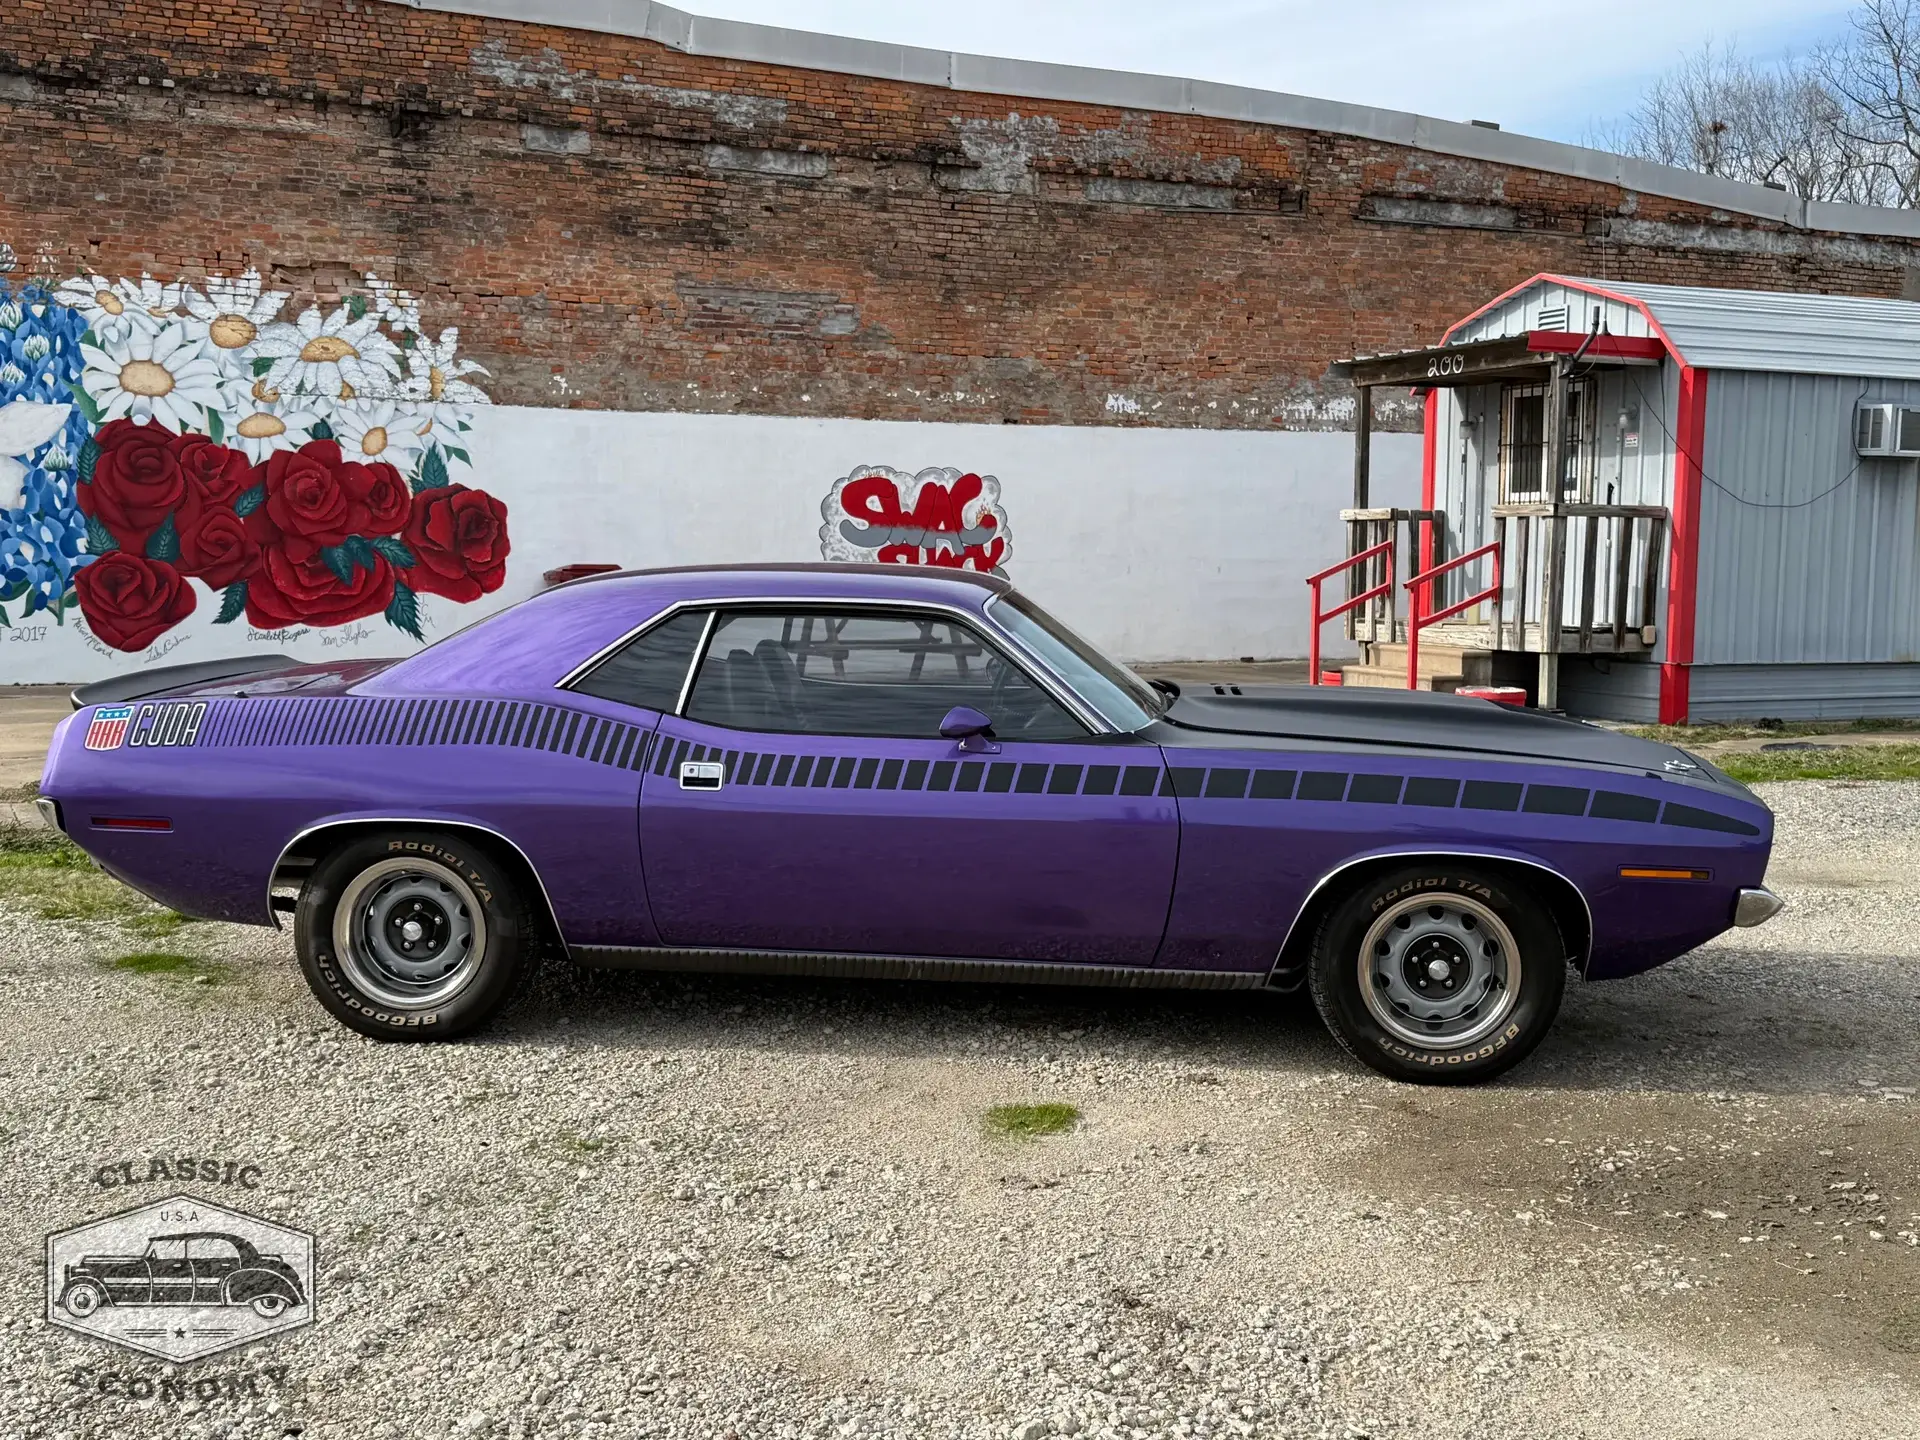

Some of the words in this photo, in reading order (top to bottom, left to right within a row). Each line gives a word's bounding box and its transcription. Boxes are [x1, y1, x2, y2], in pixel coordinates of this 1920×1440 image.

[1427, 354, 1465, 378] 200
[10, 626, 47, 642] 2017
[128, 701, 208, 748] CUDA
[388, 840, 465, 868] Radial
[469, 869, 493, 903] T/A
[1371, 876, 1448, 912] Radial
[1457, 879, 1492, 900] T/A
[317, 954, 438, 1026] BFGoodrich
[1379, 1022, 1520, 1066] BFGoodrich
